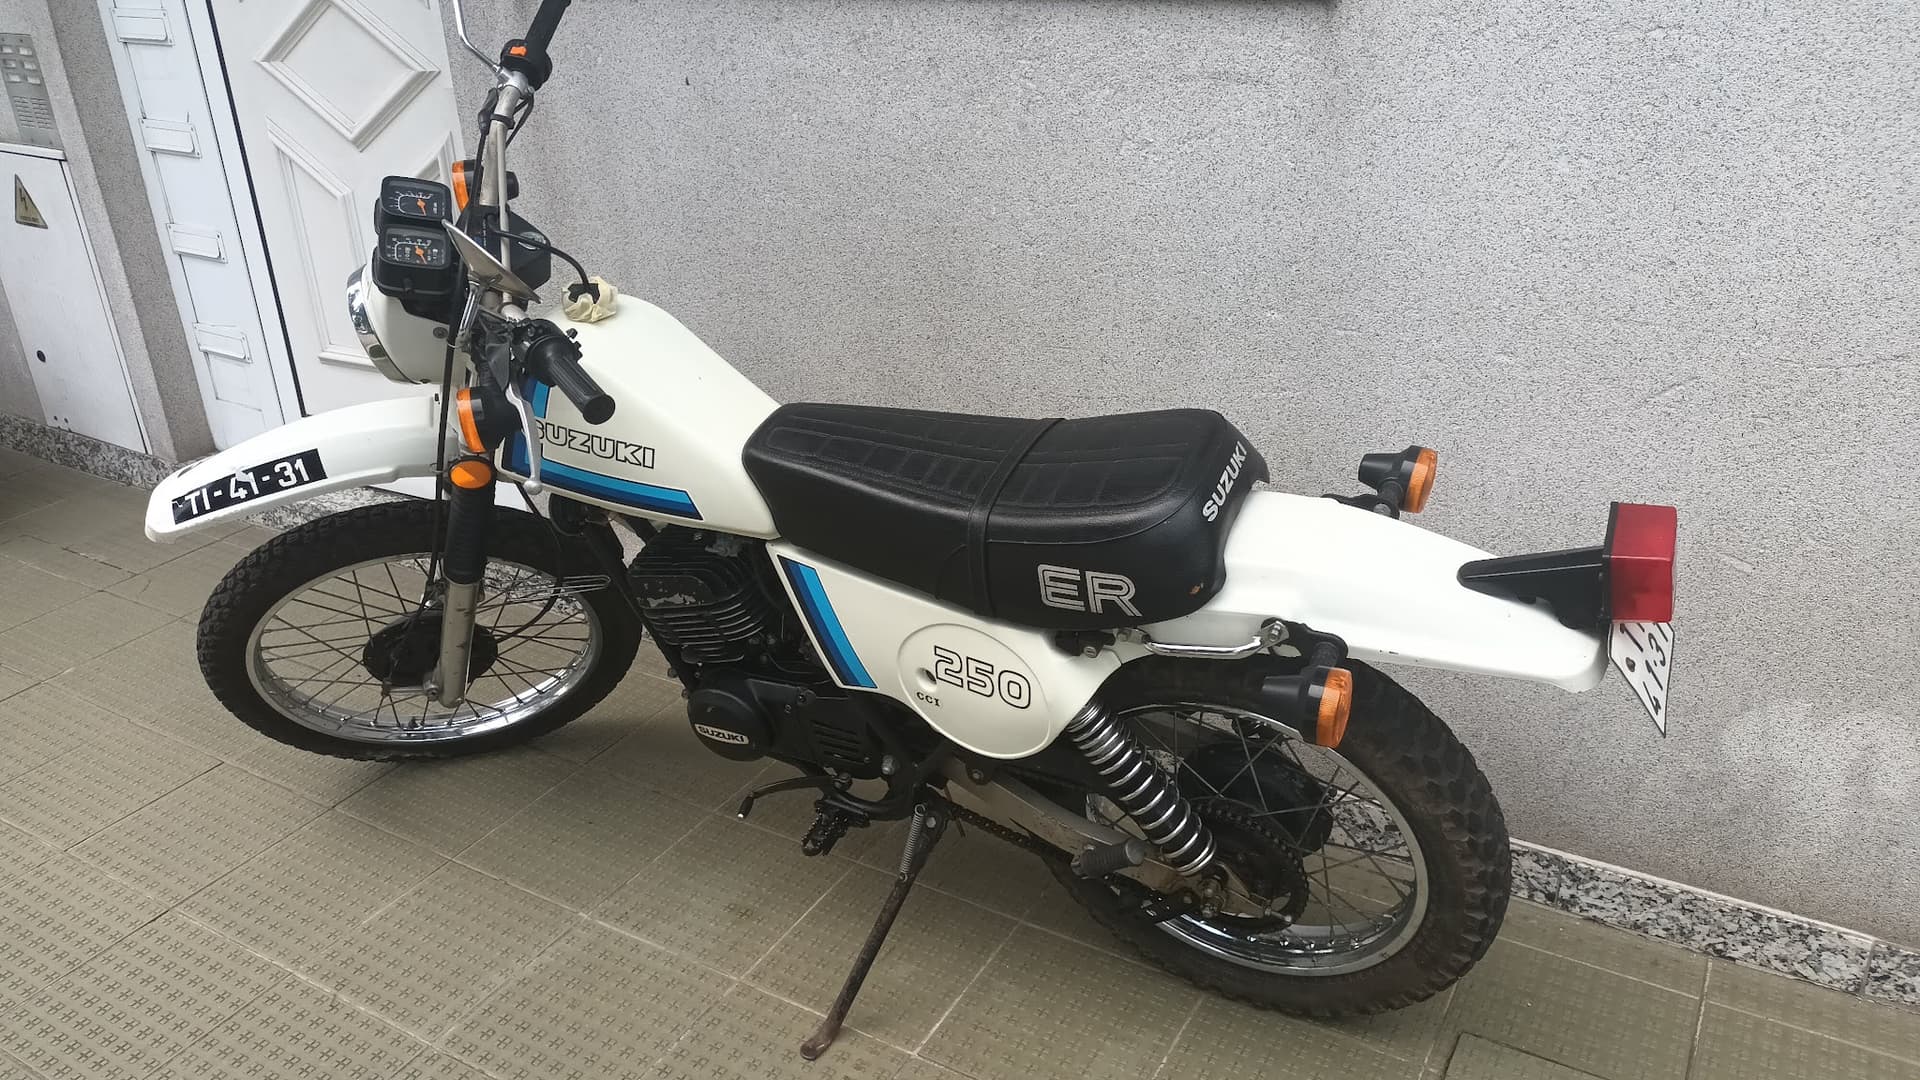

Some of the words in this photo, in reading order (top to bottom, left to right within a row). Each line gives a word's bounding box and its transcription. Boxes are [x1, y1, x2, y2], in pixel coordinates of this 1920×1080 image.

[1202, 441, 1248, 522] SUZUKI
[1037, 564, 1143, 617] ER
[934, 645, 1031, 710] 250
[698, 726, 745, 743] SUZUKI
